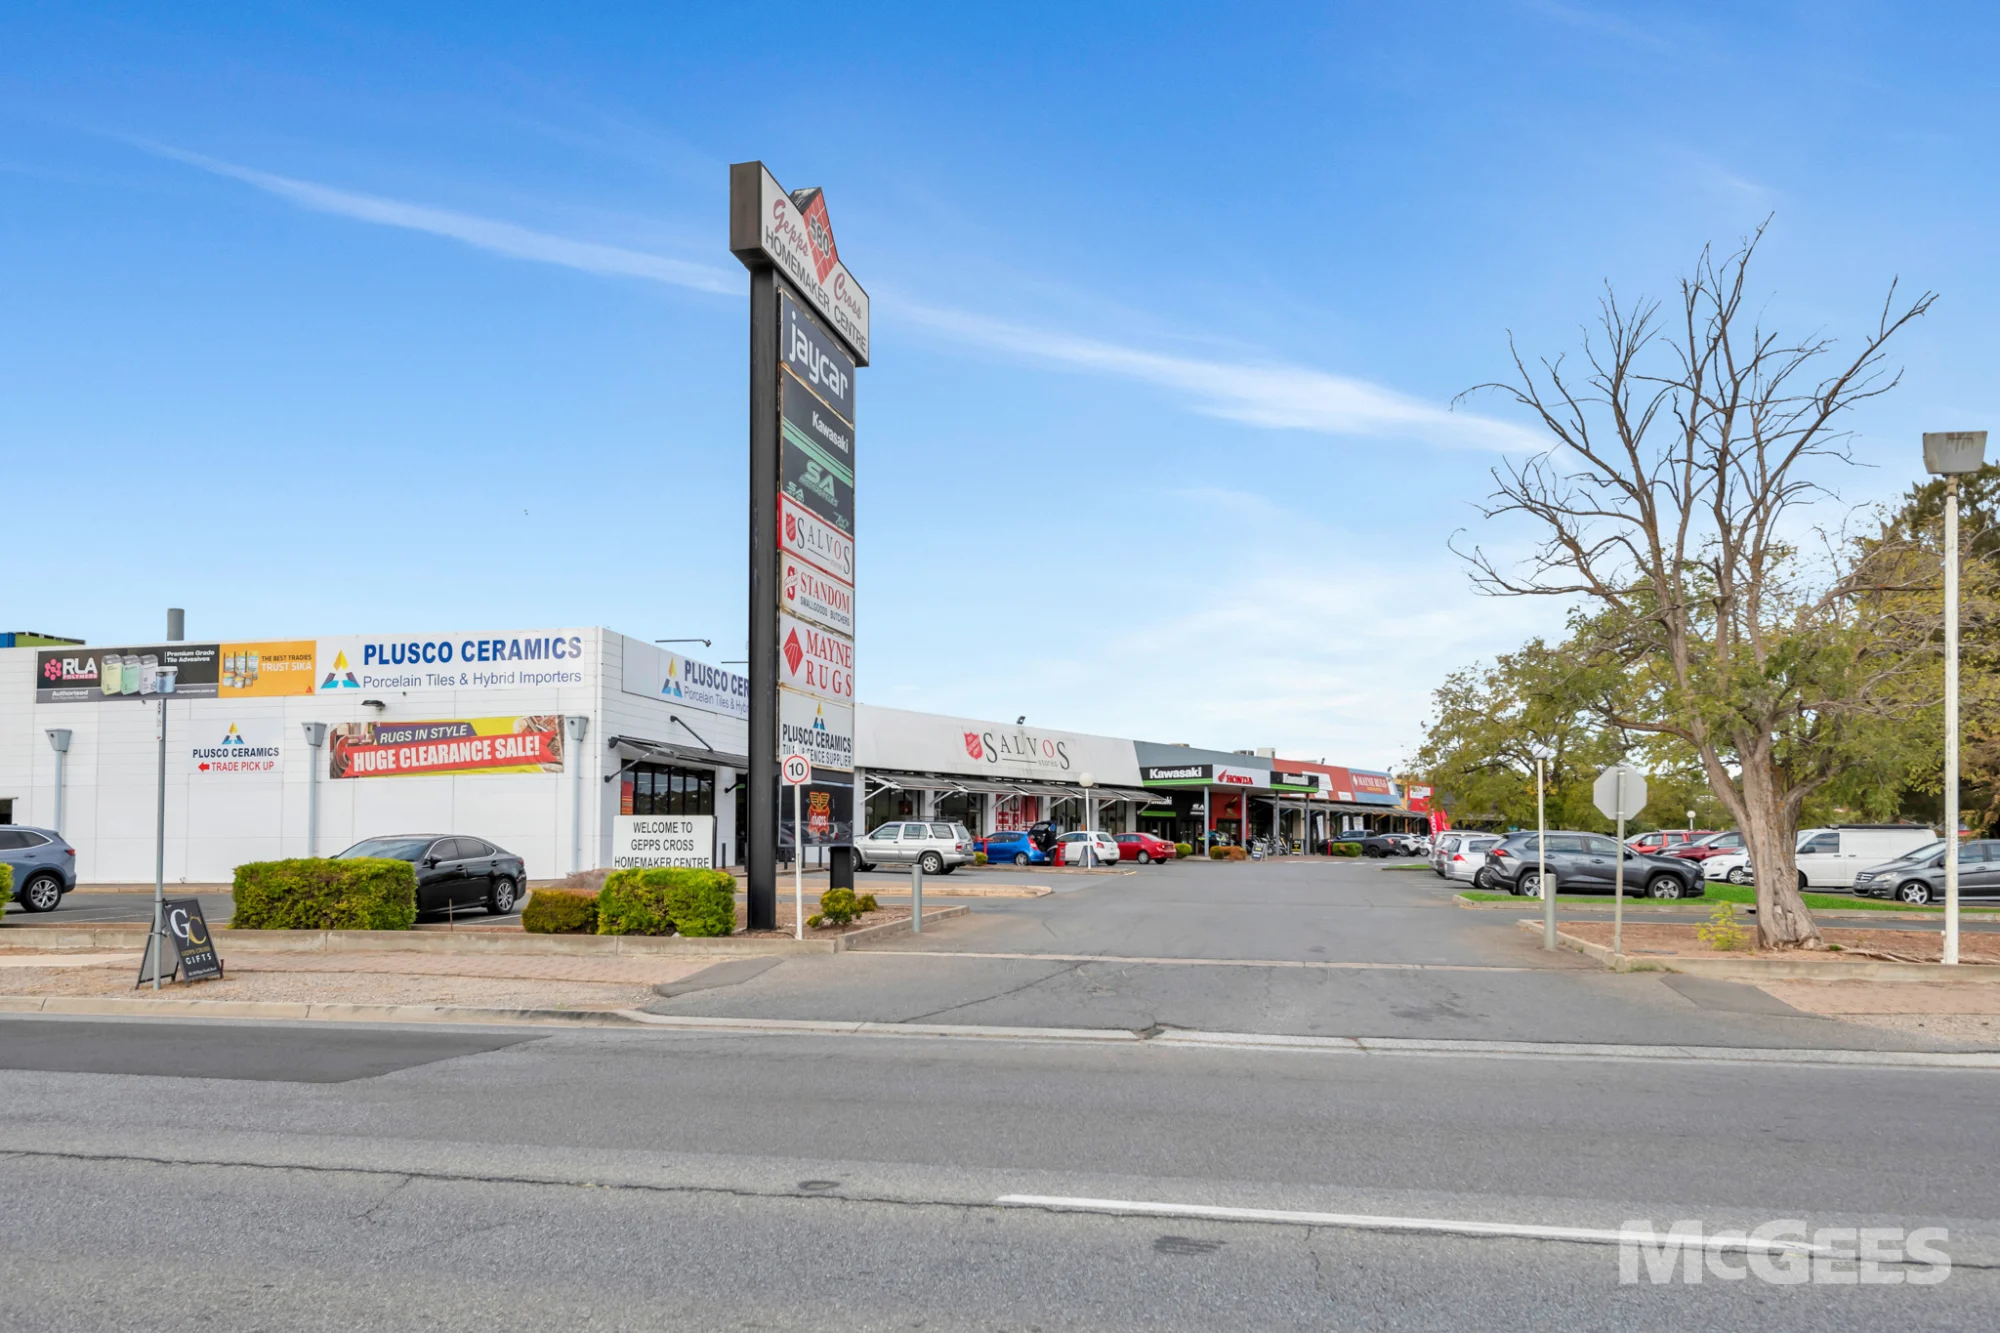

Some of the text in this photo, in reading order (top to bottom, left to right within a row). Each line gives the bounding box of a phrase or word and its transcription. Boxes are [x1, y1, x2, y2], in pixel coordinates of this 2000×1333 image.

[810, 215, 830, 257] 580
[773, 199, 862, 320] Gepps Cross
[765, 225, 867, 354] HOMEMAKER CENTRE
[789, 310, 848, 400] jaycar
[812, 411, 849, 454] Kawasaki
[797, 517, 850, 575] SALVOS
[800, 571, 850, 614] STANDOM
[364, 637, 582, 665] PLUSCO CERAMICS
[806, 629, 852, 669] MAYNE
[63, 657, 98, 675] RLA
[261, 661, 312, 671] TRUST SIKA
[685, 660, 728, 692] PLUSCO
[806, 660, 852, 697] RUGS
[363, 671, 582, 688] Porcelain Tiles & Hybrid Importers
[685, 686, 714, 705] Porcelain
[715, 693, 729, 708] Tiles
[379, 725, 468, 744] RUGS IN STYLE
[783, 724, 851, 753] PLUSCO CERAMICS
[192, 747, 280, 758] PLUSCO CERAMICS
[353, 735, 540, 772] HUGE CLEARANCE SALE!
[983, 732, 1070, 770] SALVOS
[211, 761, 274, 771] TRADE PICK UP
[789, 763, 804, 776] 10
[1149, 767, 1202, 779] Kawasaki
[1226, 775, 1253, 785] HONDA
[633, 822, 693, 833] WELCOME TO
[631, 839, 694, 851] GEPPS CROSS
[615, 856, 710, 868] HOMEMAKER CENTRE
[185, 953, 212, 965] GIFTS
